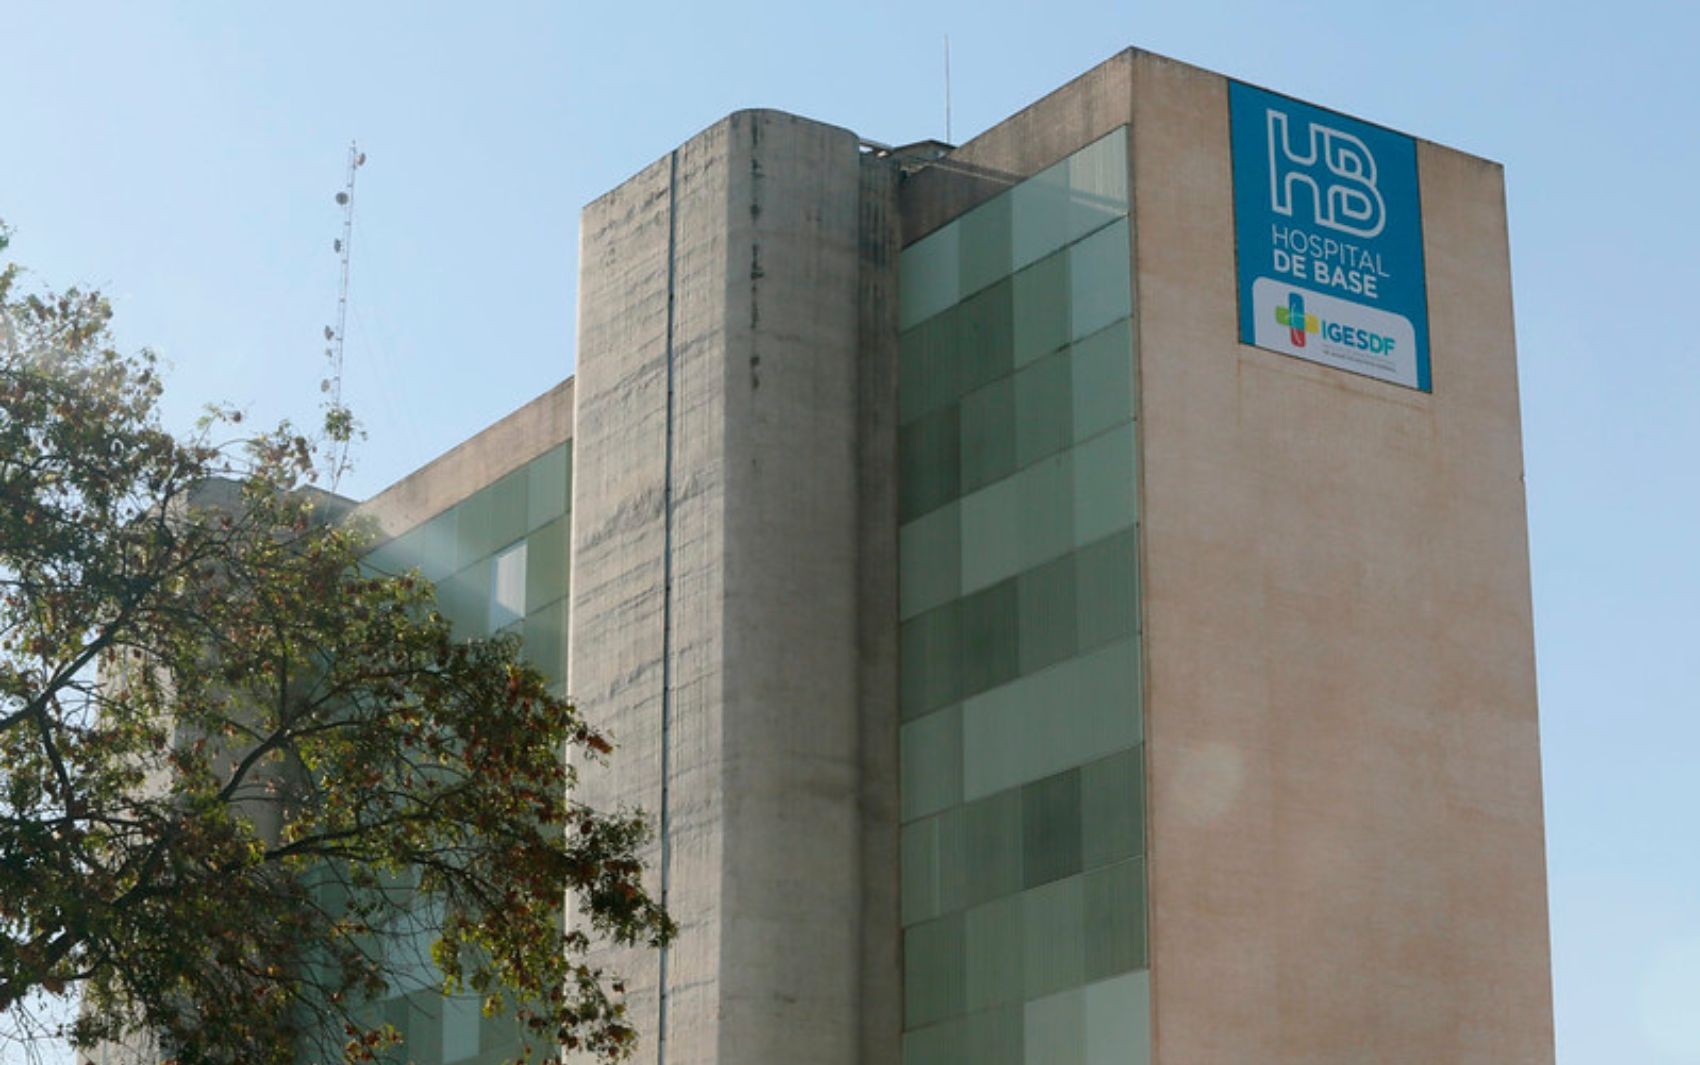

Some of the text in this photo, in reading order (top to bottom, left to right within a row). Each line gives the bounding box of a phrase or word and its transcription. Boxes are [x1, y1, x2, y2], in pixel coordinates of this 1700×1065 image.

[1271, 223, 1391, 278] HOSPITAL
[1273, 249, 1379, 299] DE BASE
[1321, 320, 1396, 356] IGESDF
